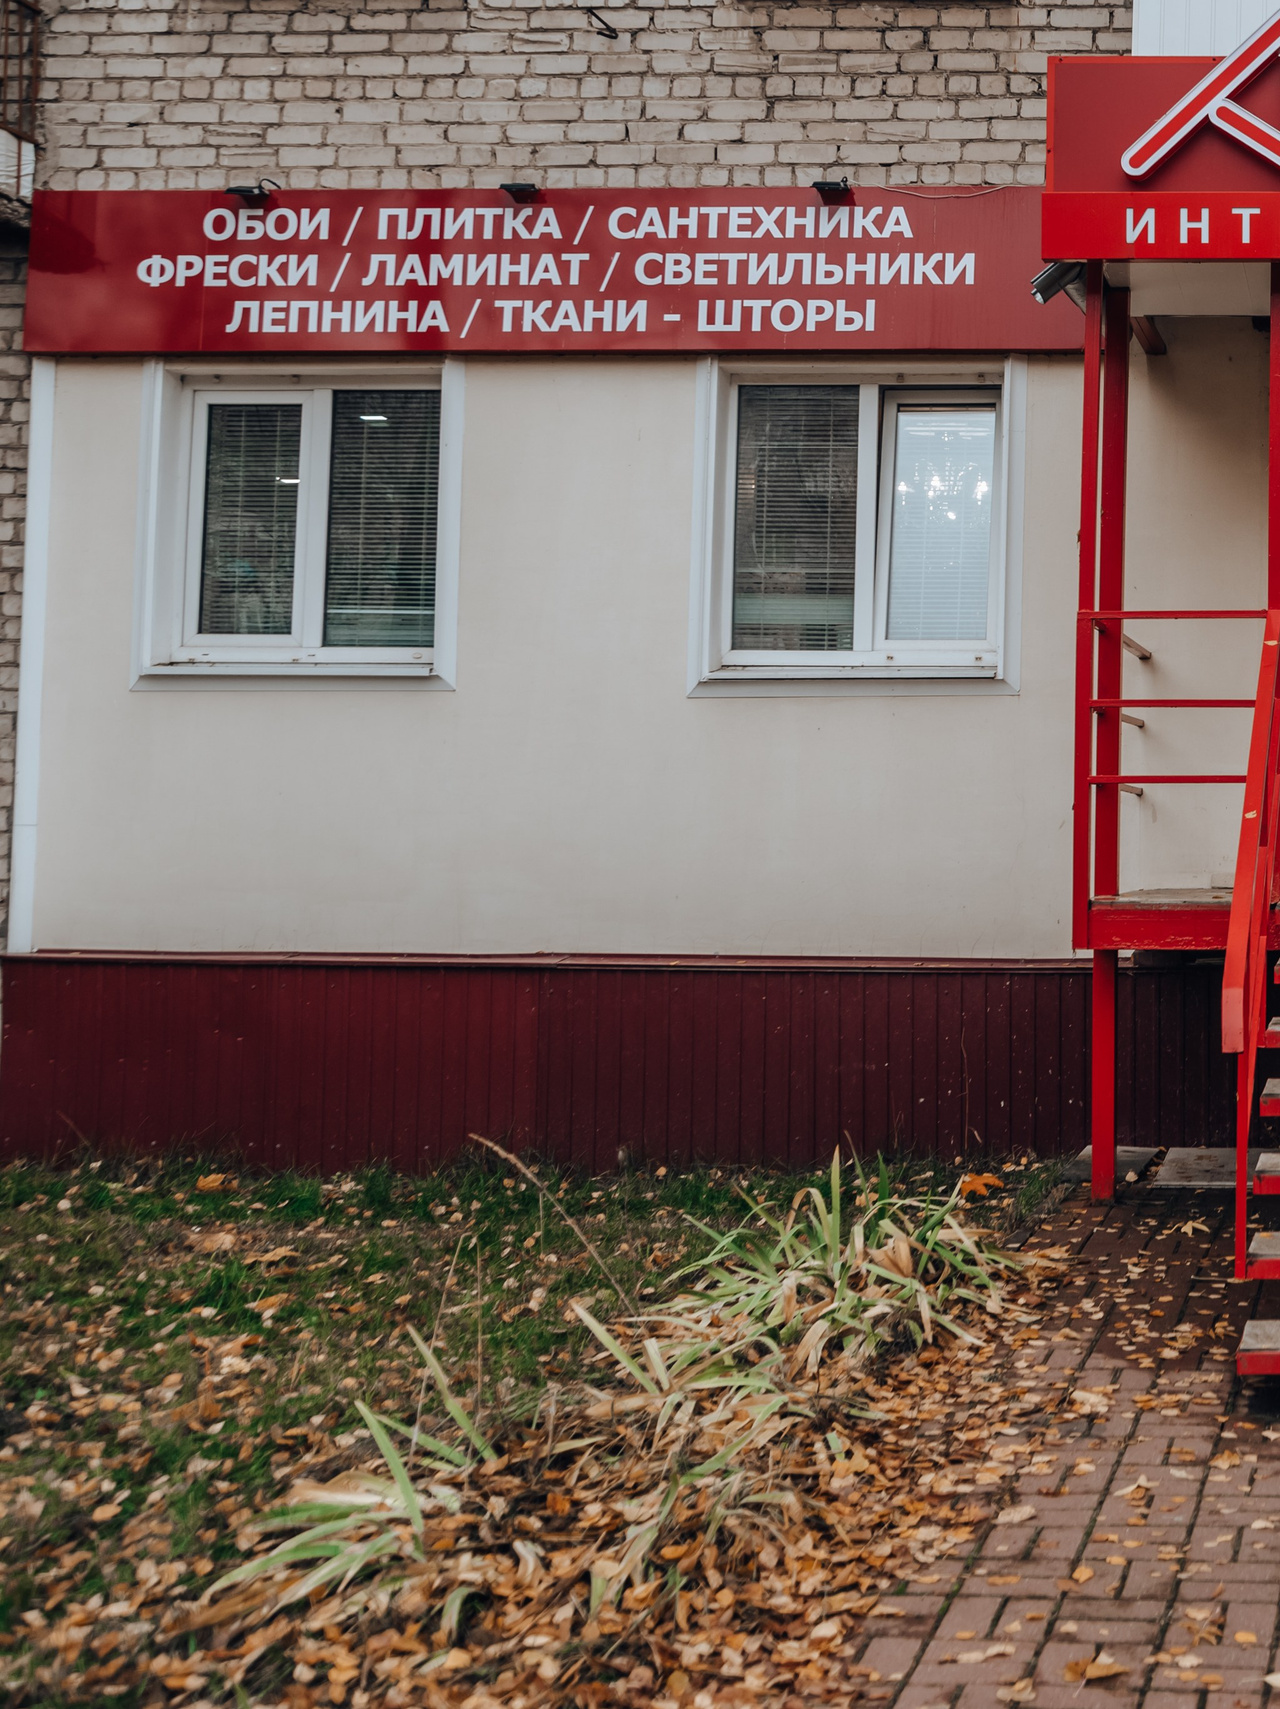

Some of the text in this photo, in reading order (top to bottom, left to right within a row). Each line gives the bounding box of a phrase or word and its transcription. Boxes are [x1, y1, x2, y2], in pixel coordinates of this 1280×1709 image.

[203, 205, 914, 247] ОБОИ / ПЛИТКА / САНТЕХНИКА
[136, 251, 976, 293] ФРЕСКИ / ЛАМИНАТ / СВЕТИЛЬНИКИ
[225, 298, 876, 339] ЛЕПНИНА / ТКАНИ - ШТОРЫ
